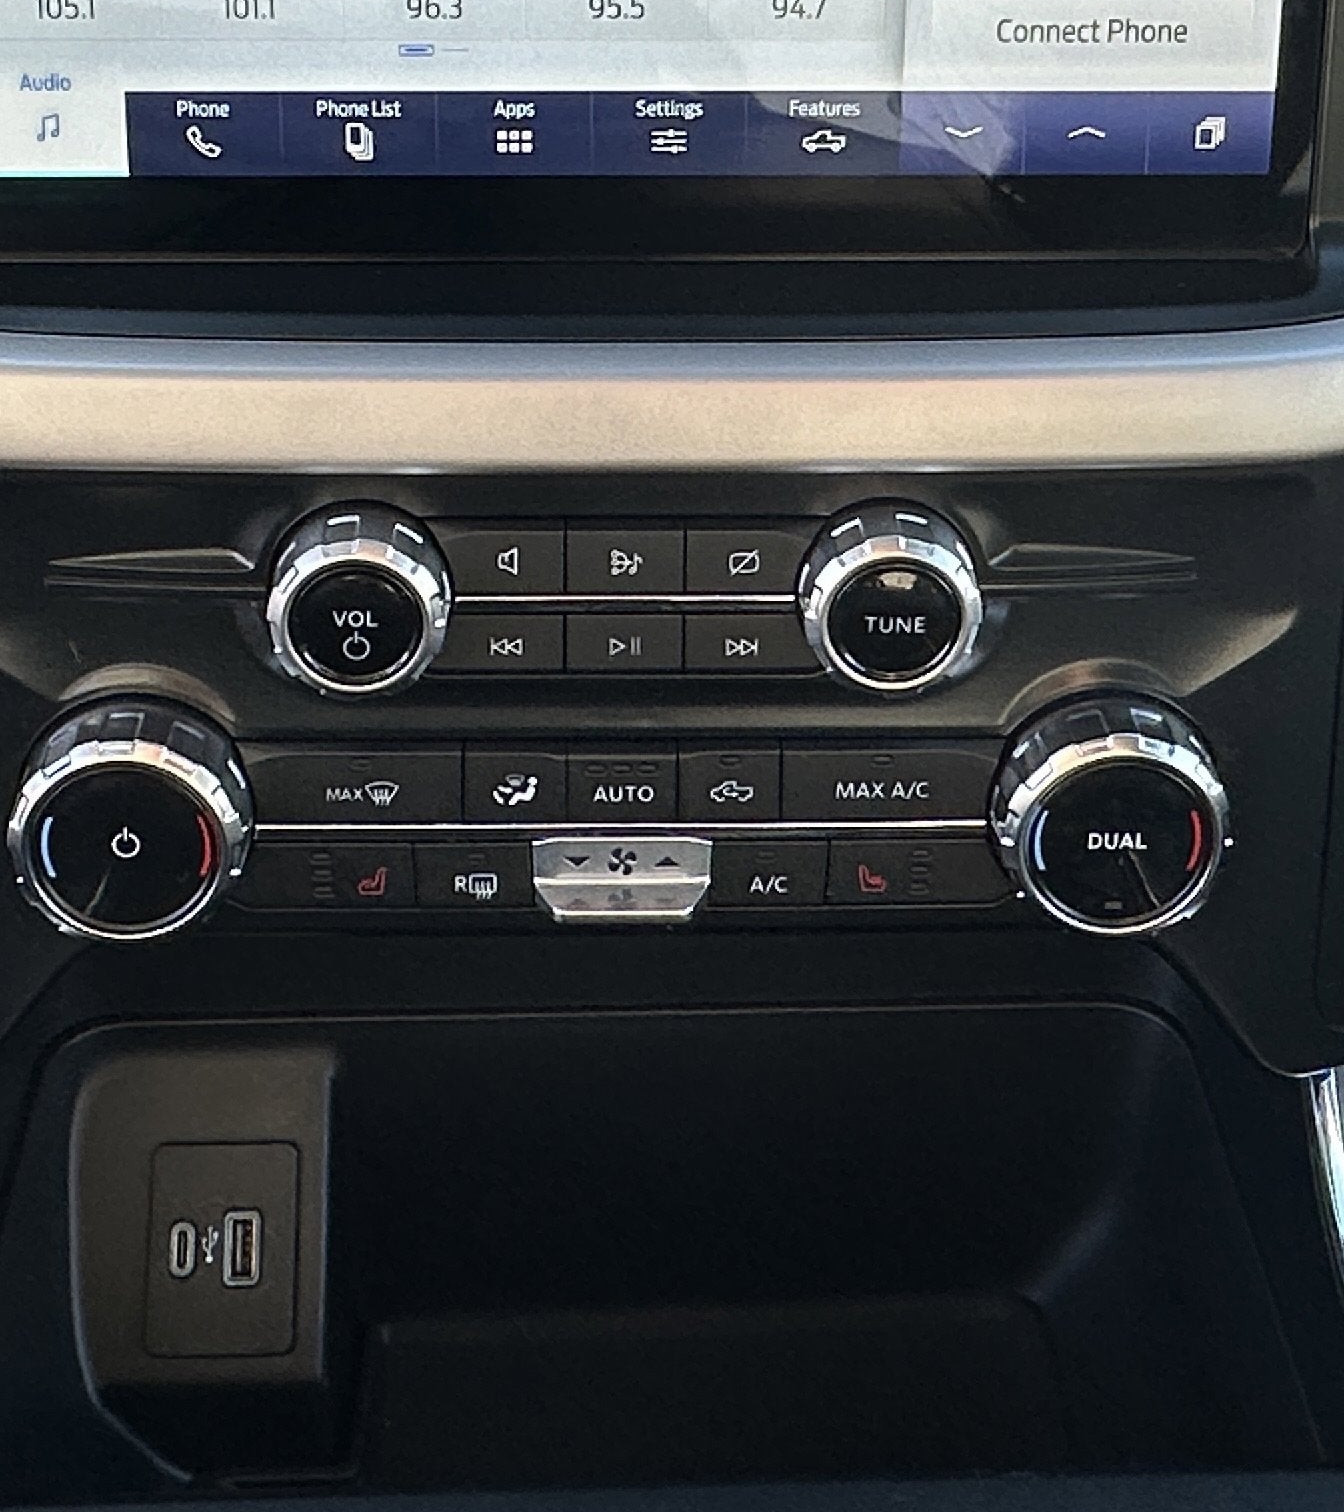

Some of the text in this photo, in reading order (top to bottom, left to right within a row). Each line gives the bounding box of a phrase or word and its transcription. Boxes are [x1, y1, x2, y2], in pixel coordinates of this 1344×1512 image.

[996, 18, 1188, 44] Connect Phone
[20, 72, 72, 92] Audio
[176, 99, 230, 118] Phone
[316, 99, 402, 118] Phone List
[493, 99, 536, 120] Apps
[635, 99, 704, 120] Settings
[788, 99, 861, 118] Features
[332, 610, 378, 628] VOL
[864, 616, 926, 634] TUNE
[326, 787, 364, 802] MAX
[593, 785, 654, 802] AUTO
[835, 781, 928, 800] MAX A/C
[1087, 832, 1148, 850] DUAL
[750, 876, 788, 894] A/C
